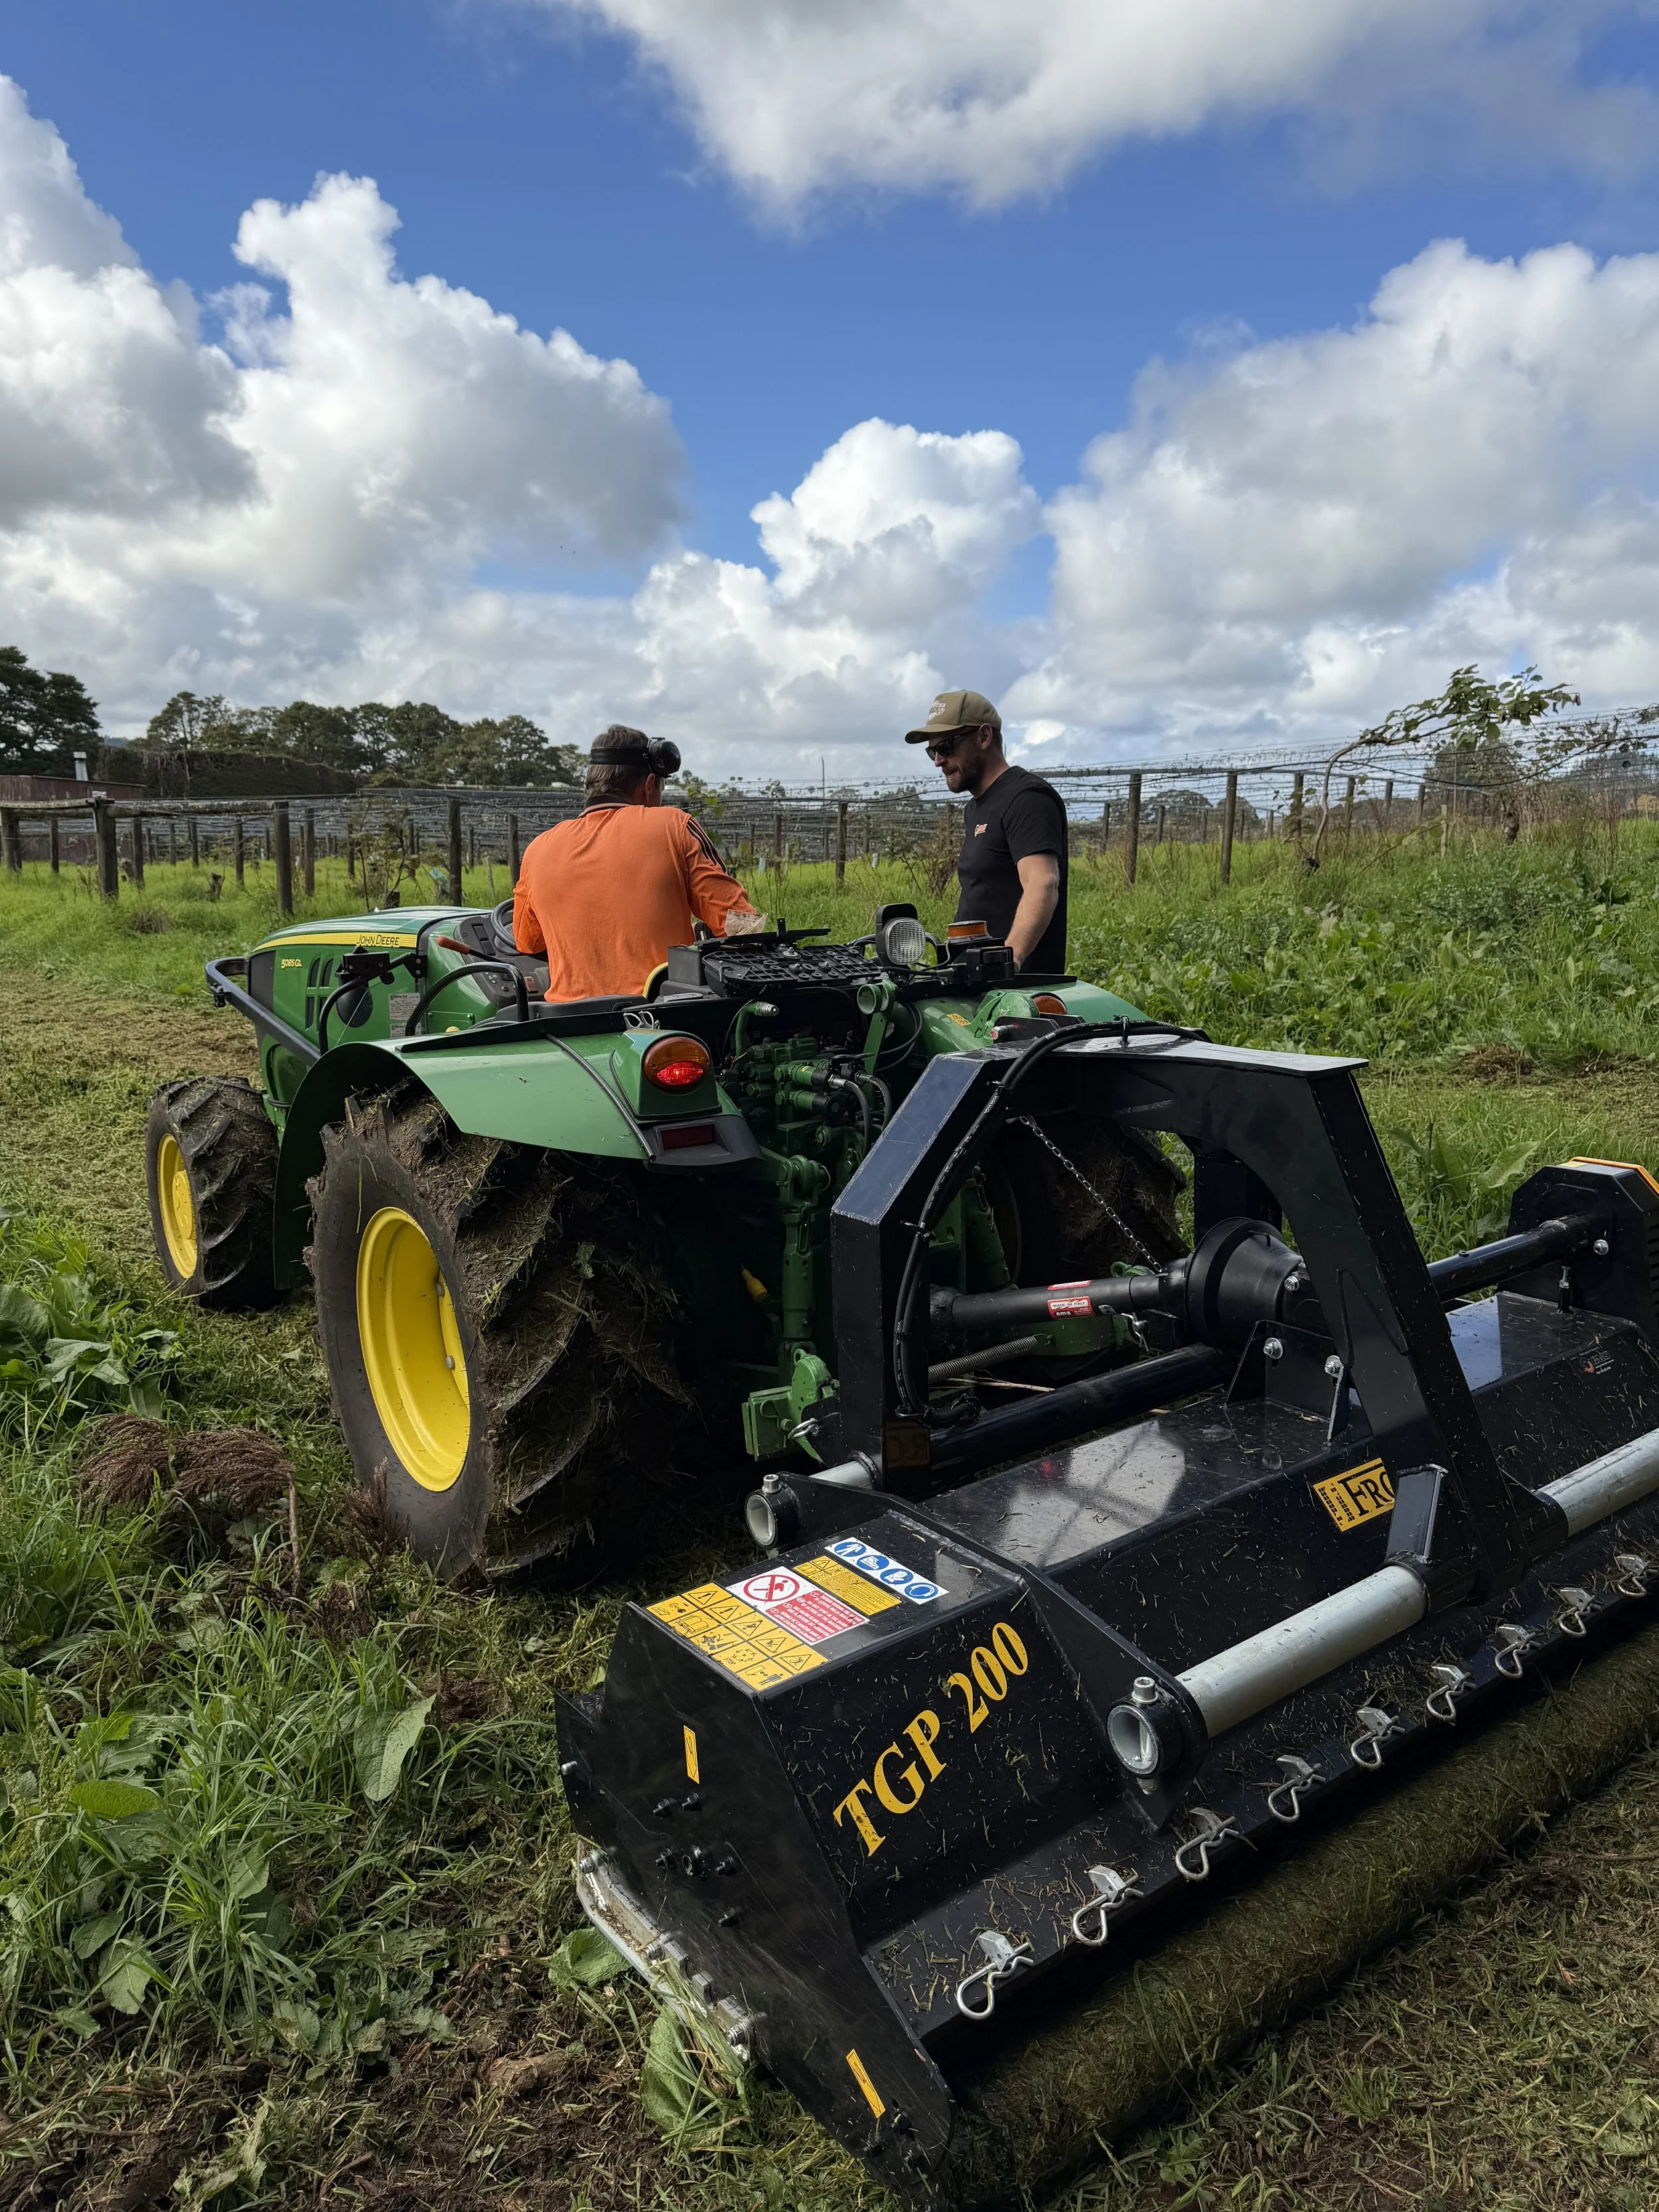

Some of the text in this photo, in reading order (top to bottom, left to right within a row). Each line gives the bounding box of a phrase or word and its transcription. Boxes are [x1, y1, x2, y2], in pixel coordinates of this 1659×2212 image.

[356, 934, 399, 946] JOHN DEERE
[832, 1710, 947, 1857] TGP
[946, 1622, 1029, 1733] 200
